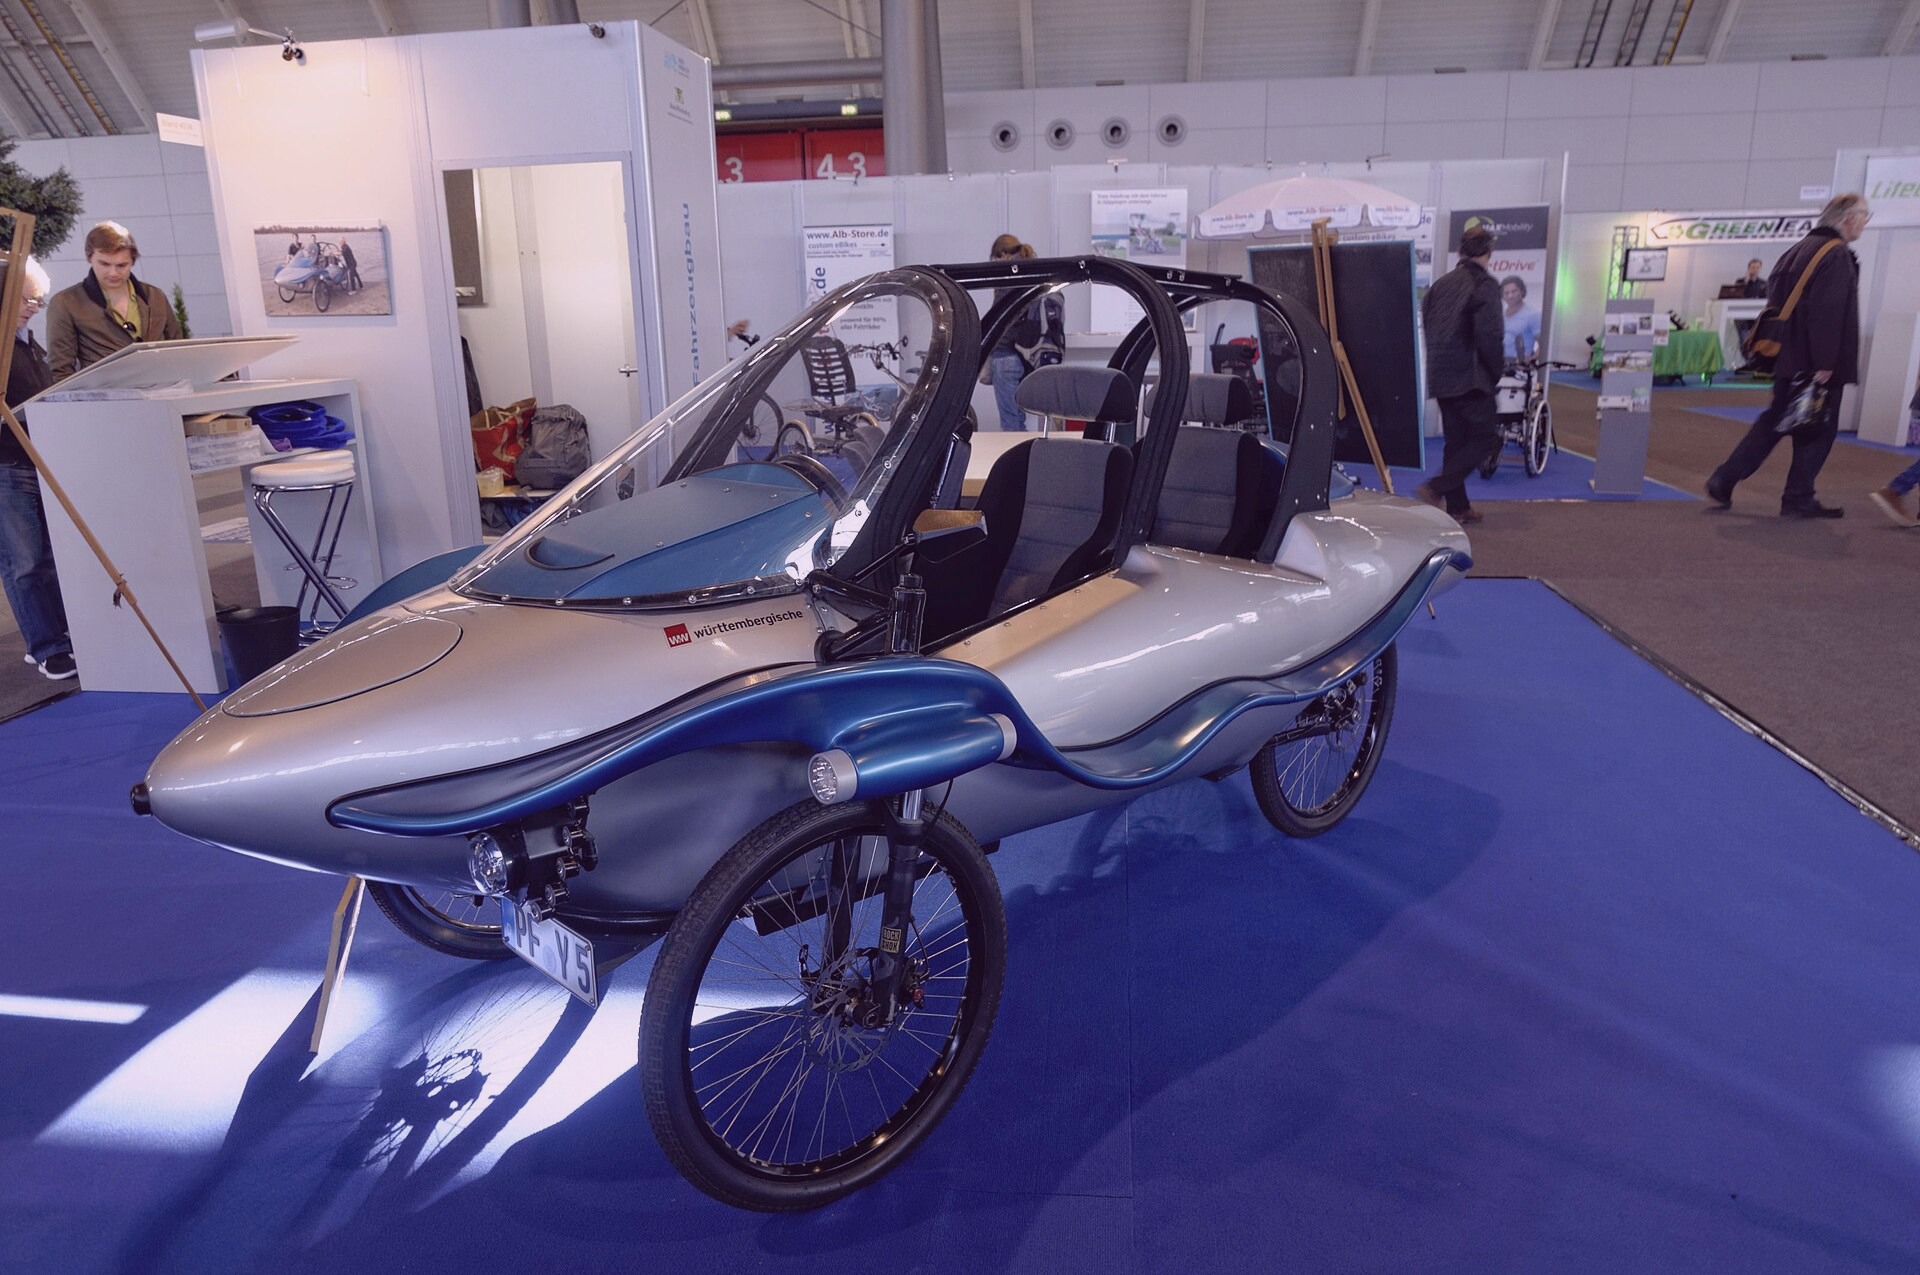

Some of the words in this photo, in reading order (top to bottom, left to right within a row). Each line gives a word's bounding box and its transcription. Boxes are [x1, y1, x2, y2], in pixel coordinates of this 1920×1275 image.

[806, 229, 889, 240] www.Alb-Store.de
[1686, 216, 1813, 239] GREENTEA
[683, 203, 702, 388] Fahrzeugbau
[694, 610, 804, 639] württembergische
[514, 902, 541, 957] PF
